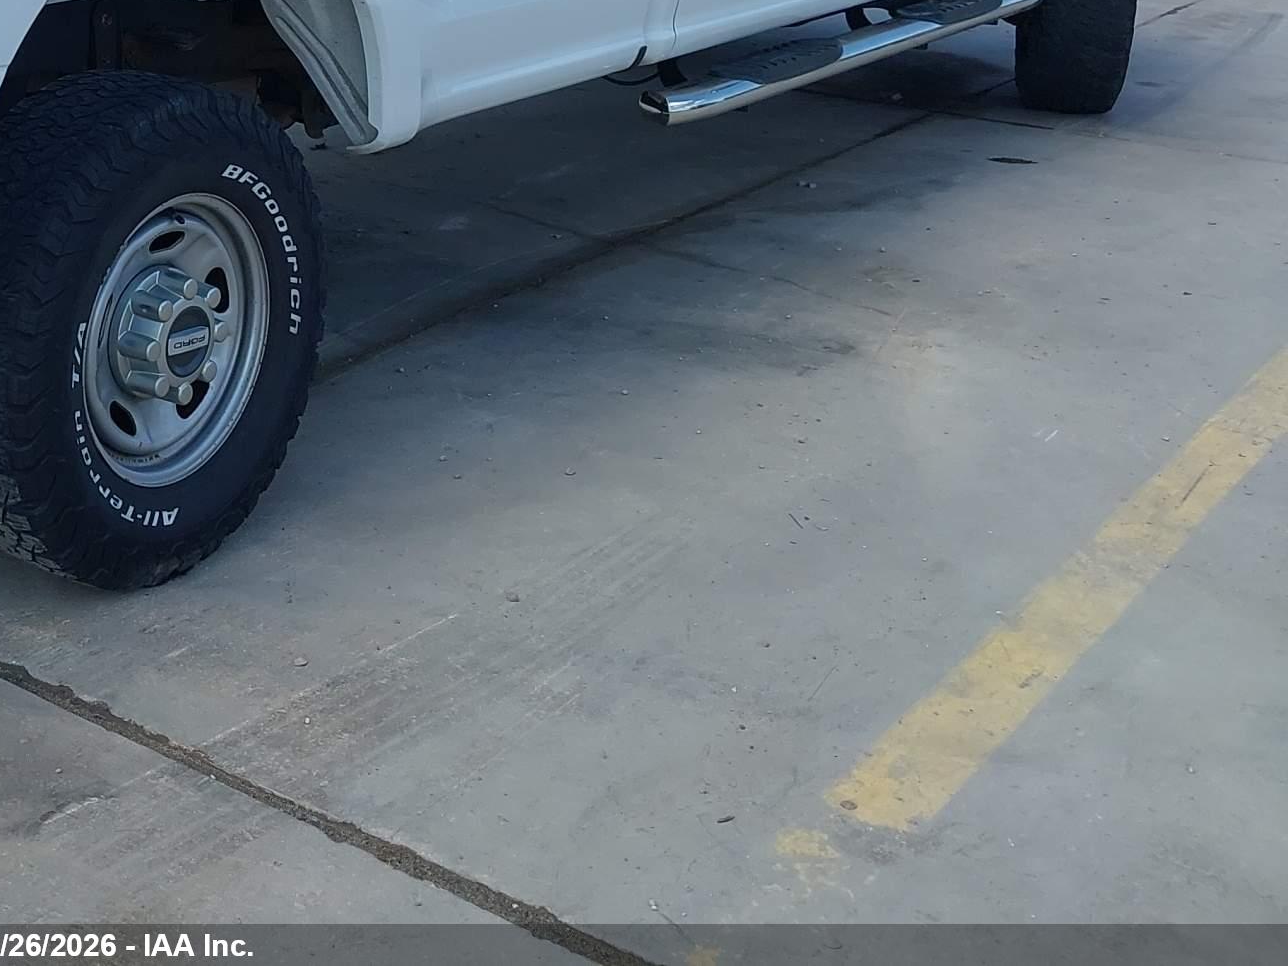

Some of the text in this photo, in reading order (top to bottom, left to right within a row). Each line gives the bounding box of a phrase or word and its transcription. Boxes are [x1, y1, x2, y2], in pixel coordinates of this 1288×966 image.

[221, 163, 302, 335] BFGoodrich
[173, 334, 206, 350] FORD
[73, 410, 180, 527] All-Terrain
